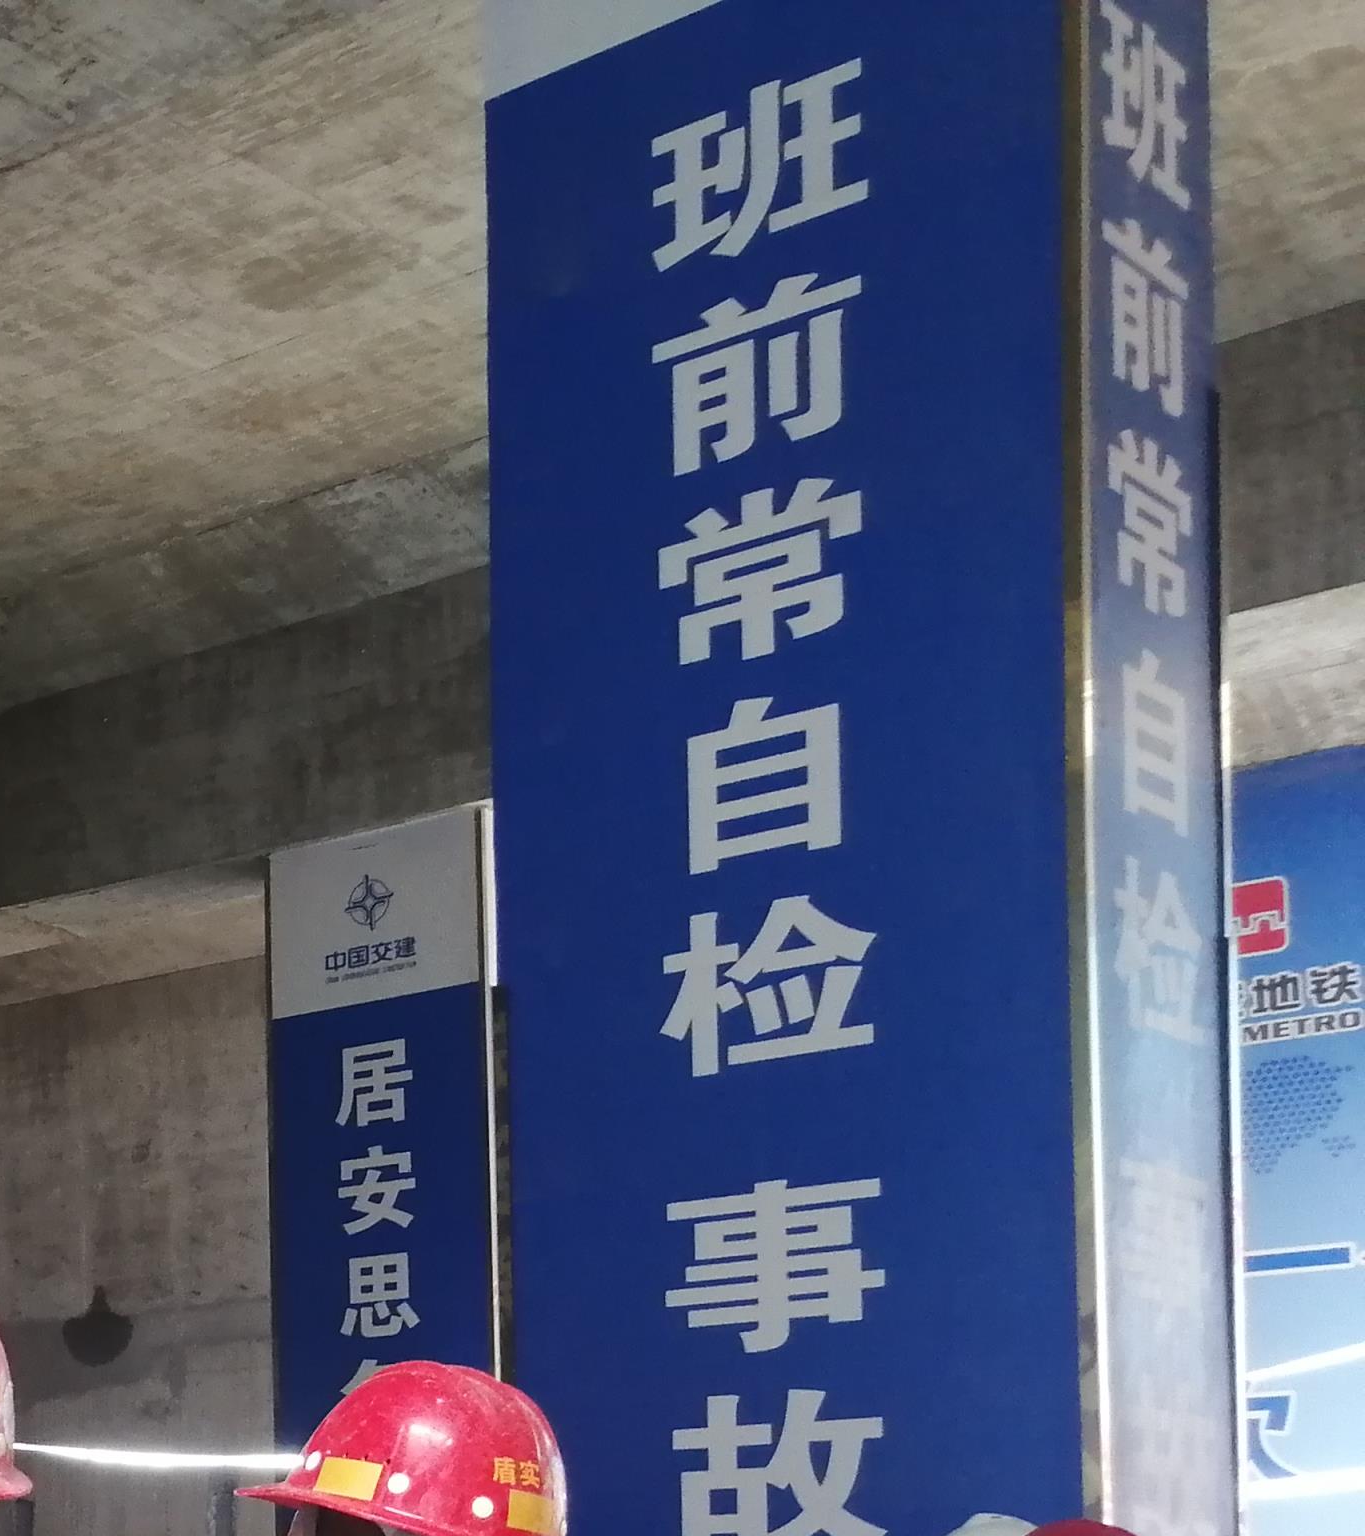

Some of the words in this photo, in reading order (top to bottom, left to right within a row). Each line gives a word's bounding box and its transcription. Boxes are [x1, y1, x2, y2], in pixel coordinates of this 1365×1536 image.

[650, 57, 877, 1078] 班前常自检
[325, 936, 417, 972] 中国交建
[1238, 963, 1359, 1020] 地铁
[1243, 1012, 1360, 1041] METRO
[335, 1038, 421, 1397] 居安思
